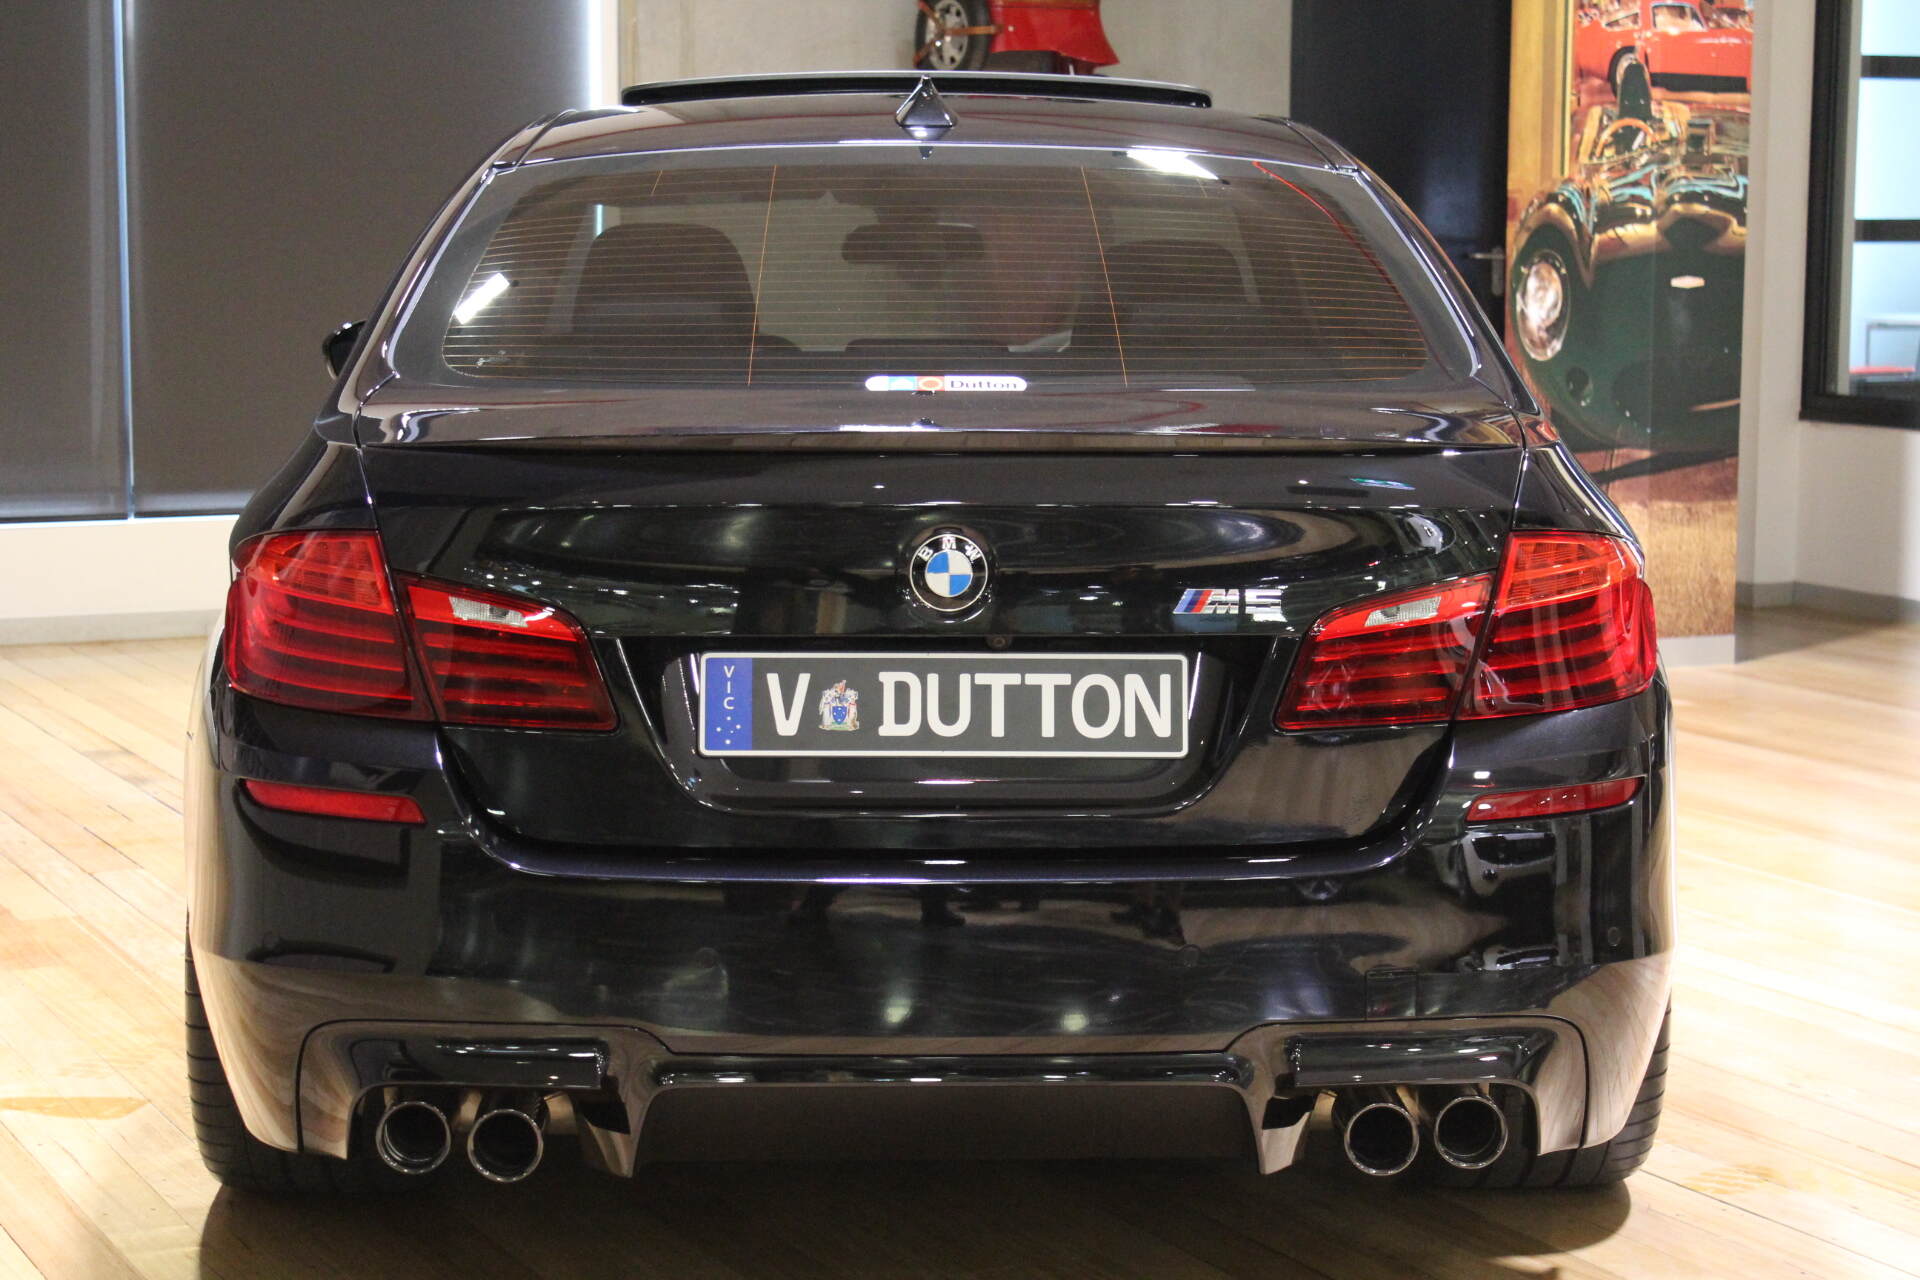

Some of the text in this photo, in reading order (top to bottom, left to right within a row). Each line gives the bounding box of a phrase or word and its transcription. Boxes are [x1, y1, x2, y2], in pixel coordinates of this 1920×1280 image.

[950, 379, 1018, 390] Dutton
[917, 535, 983, 563] BMW
[1173, 588, 1283, 616] M5
[722, 665, 736, 710] VIC
[766, 671, 1172, 738] V DUTTON
